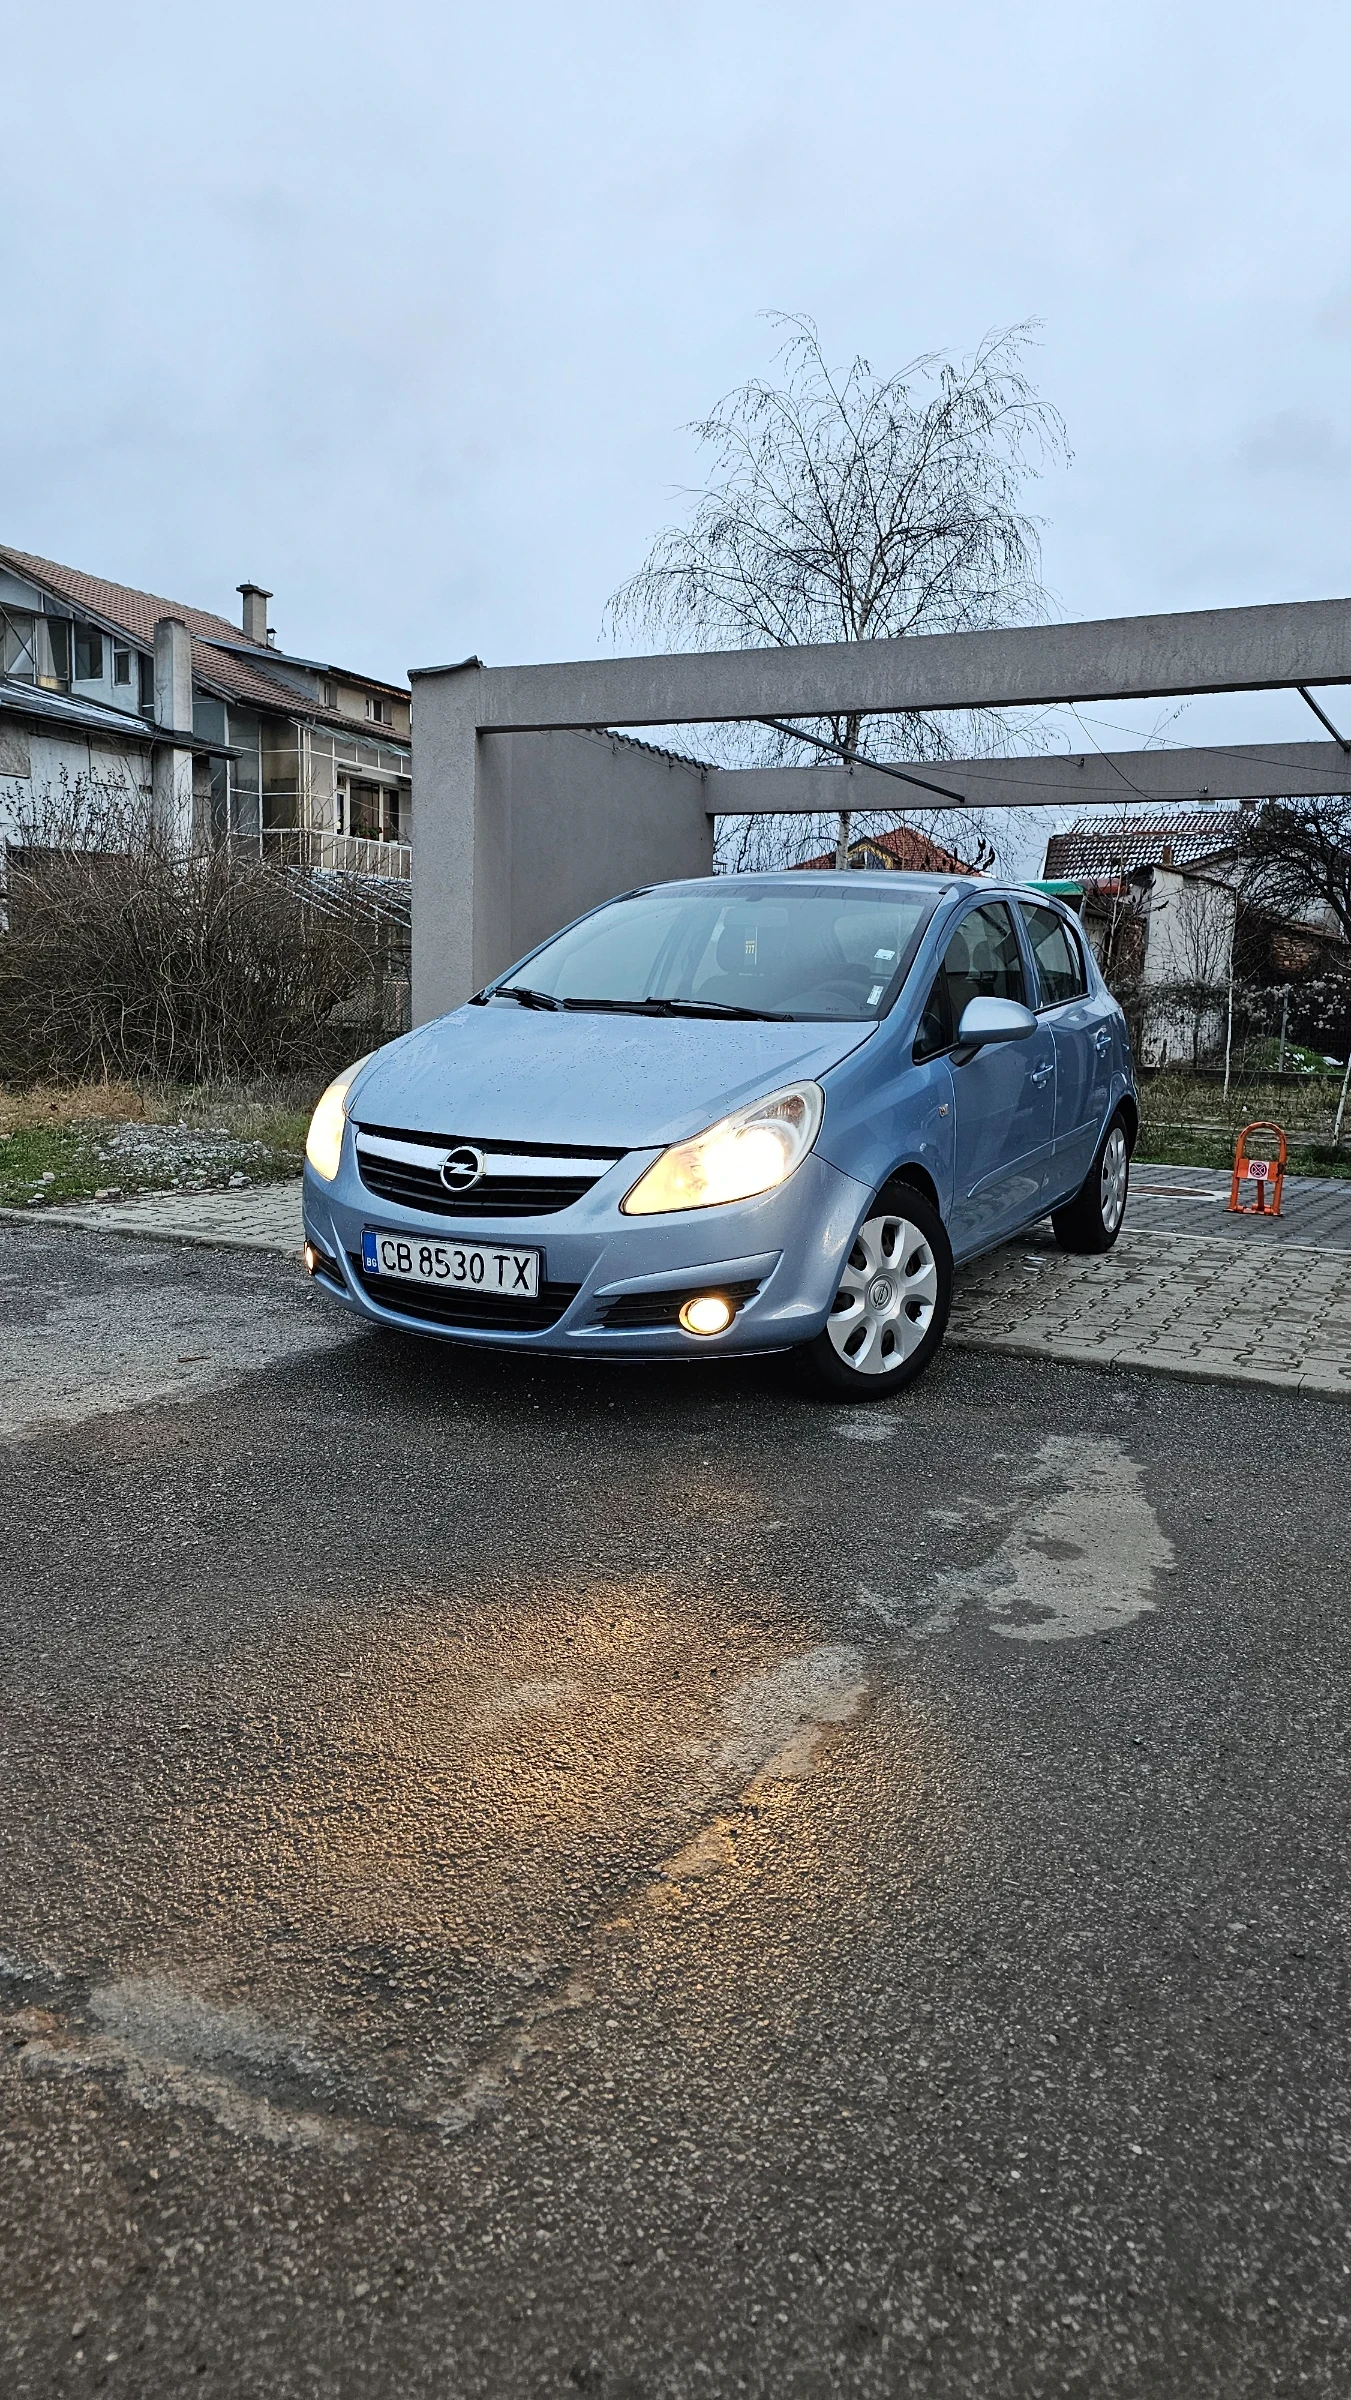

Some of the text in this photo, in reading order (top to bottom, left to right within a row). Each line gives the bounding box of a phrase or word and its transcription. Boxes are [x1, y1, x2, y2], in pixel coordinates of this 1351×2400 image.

[366, 1257, 377, 1267] BG
[381, 1240, 531, 1290] CB 8530 TX
